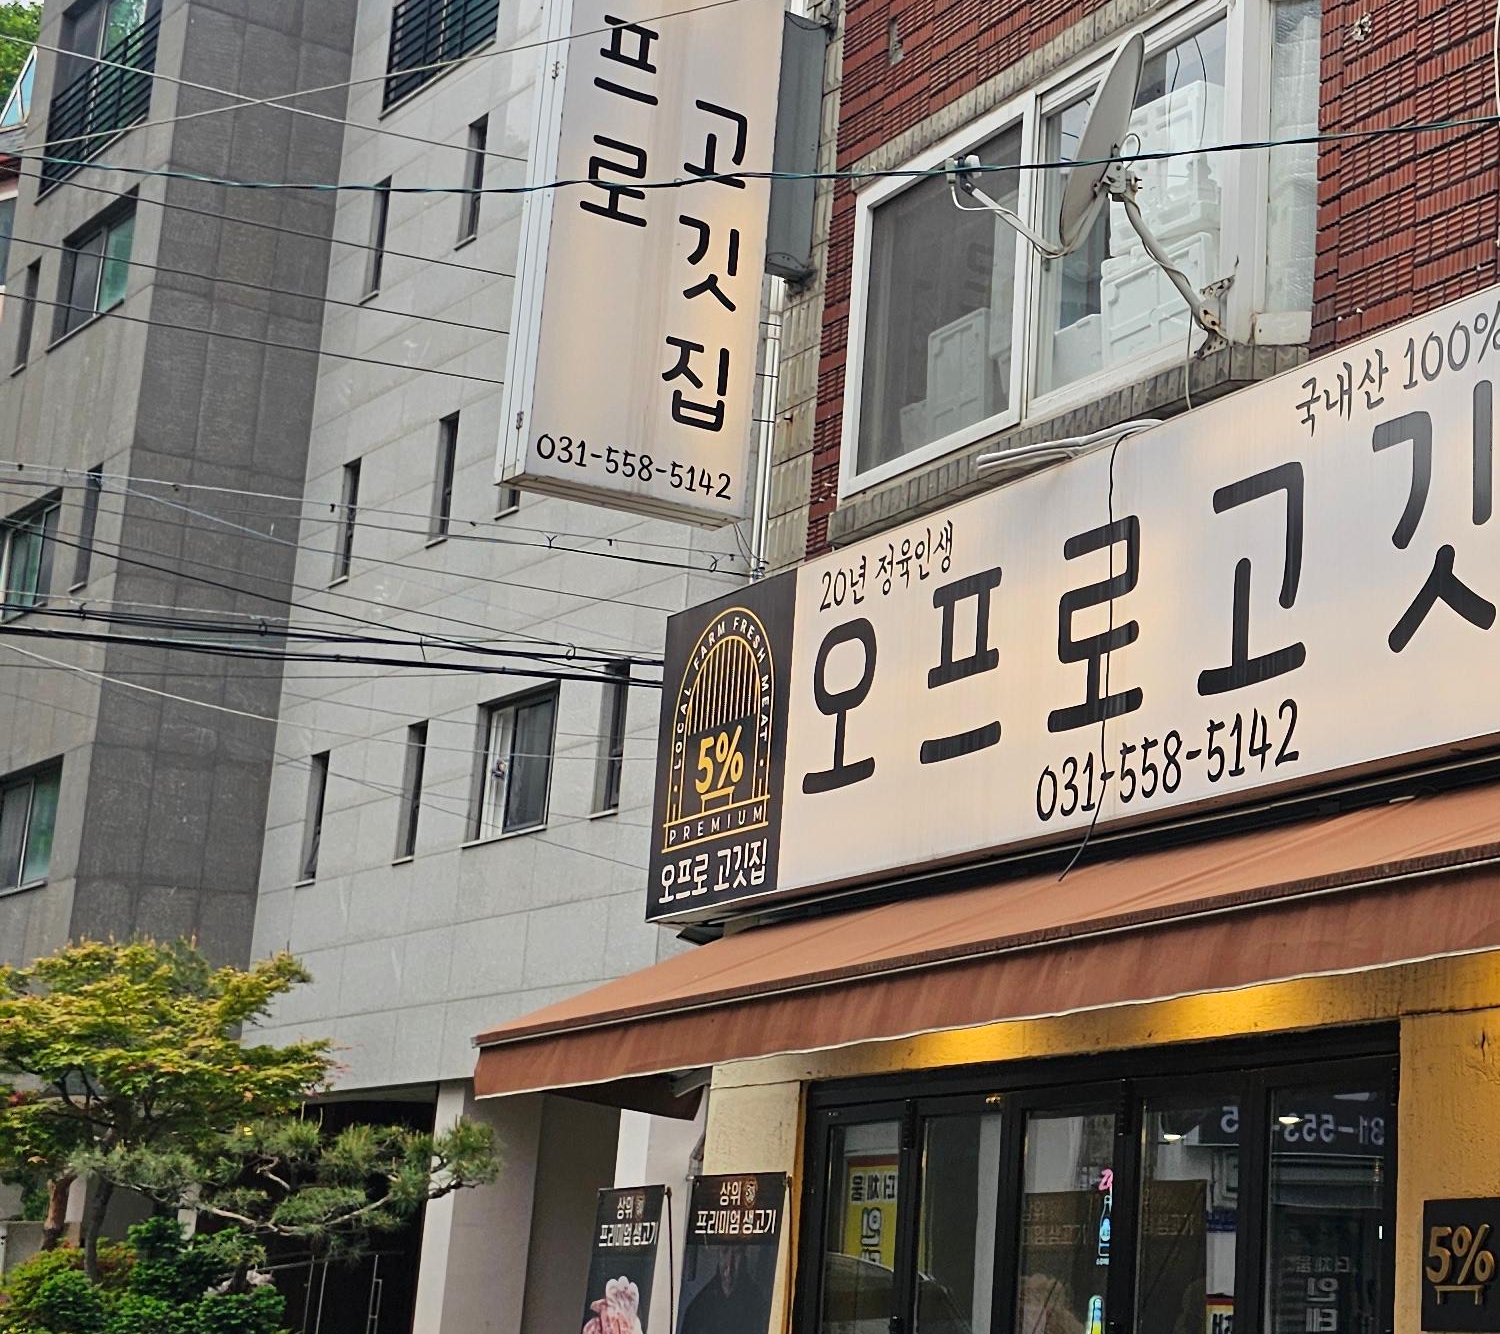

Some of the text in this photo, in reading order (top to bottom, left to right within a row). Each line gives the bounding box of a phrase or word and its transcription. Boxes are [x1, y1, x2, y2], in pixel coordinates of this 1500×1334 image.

[661, 98, 749, 433] 고깃집
[1295, 347, 1389, 438] 국내산
[535, 431, 733, 502] 031-558-5142
[819, 519, 955, 614] 20년 정육인생
[673, 616, 772, 771] LOCAL FARM FRESH MEAT
[694, 724, 745, 795] 5%
[1035, 698, 1302, 824] 031-558-5142
[668, 804, 763, 846] PREMIUM
[658, 837, 769, 905] 오프로 고깃집
[694, 1208, 777, 1235] 프리미엄 생고기
[719, 1180, 742, 1207] 상위
[633, 1221, 659, 1247] 생고기
[1425, 1223, 1496, 1285] 5%
